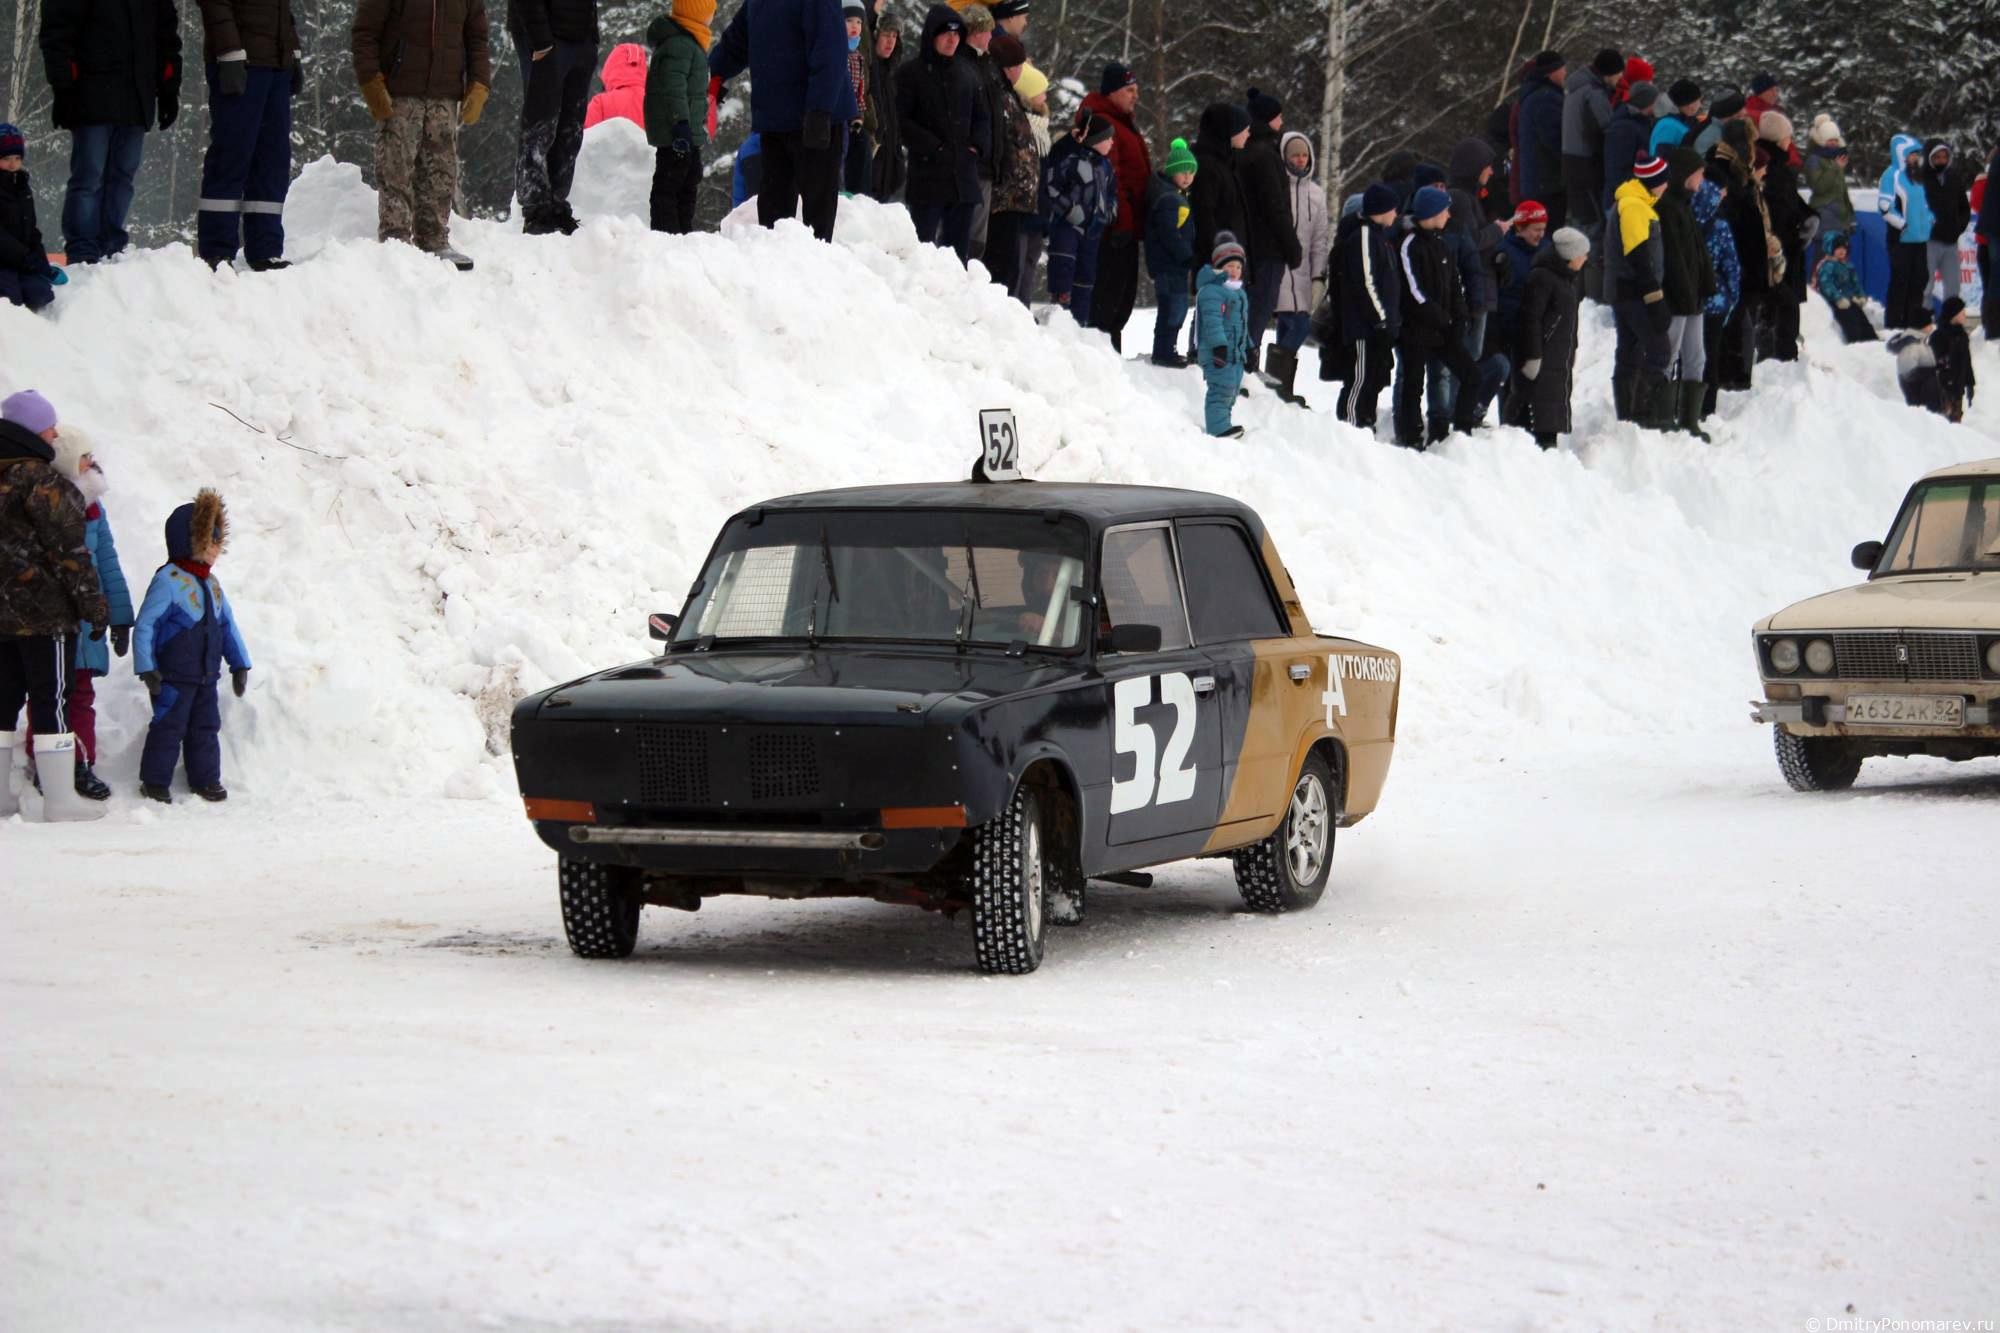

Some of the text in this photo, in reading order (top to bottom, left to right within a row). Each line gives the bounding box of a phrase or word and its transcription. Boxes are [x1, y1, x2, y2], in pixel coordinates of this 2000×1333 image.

[988, 422, 1014, 472] 52
[1322, 654, 1397, 729] AVTOKROSS
[1935, 700, 1955, 716] 52
[1110, 672, 1197, 815] 52
